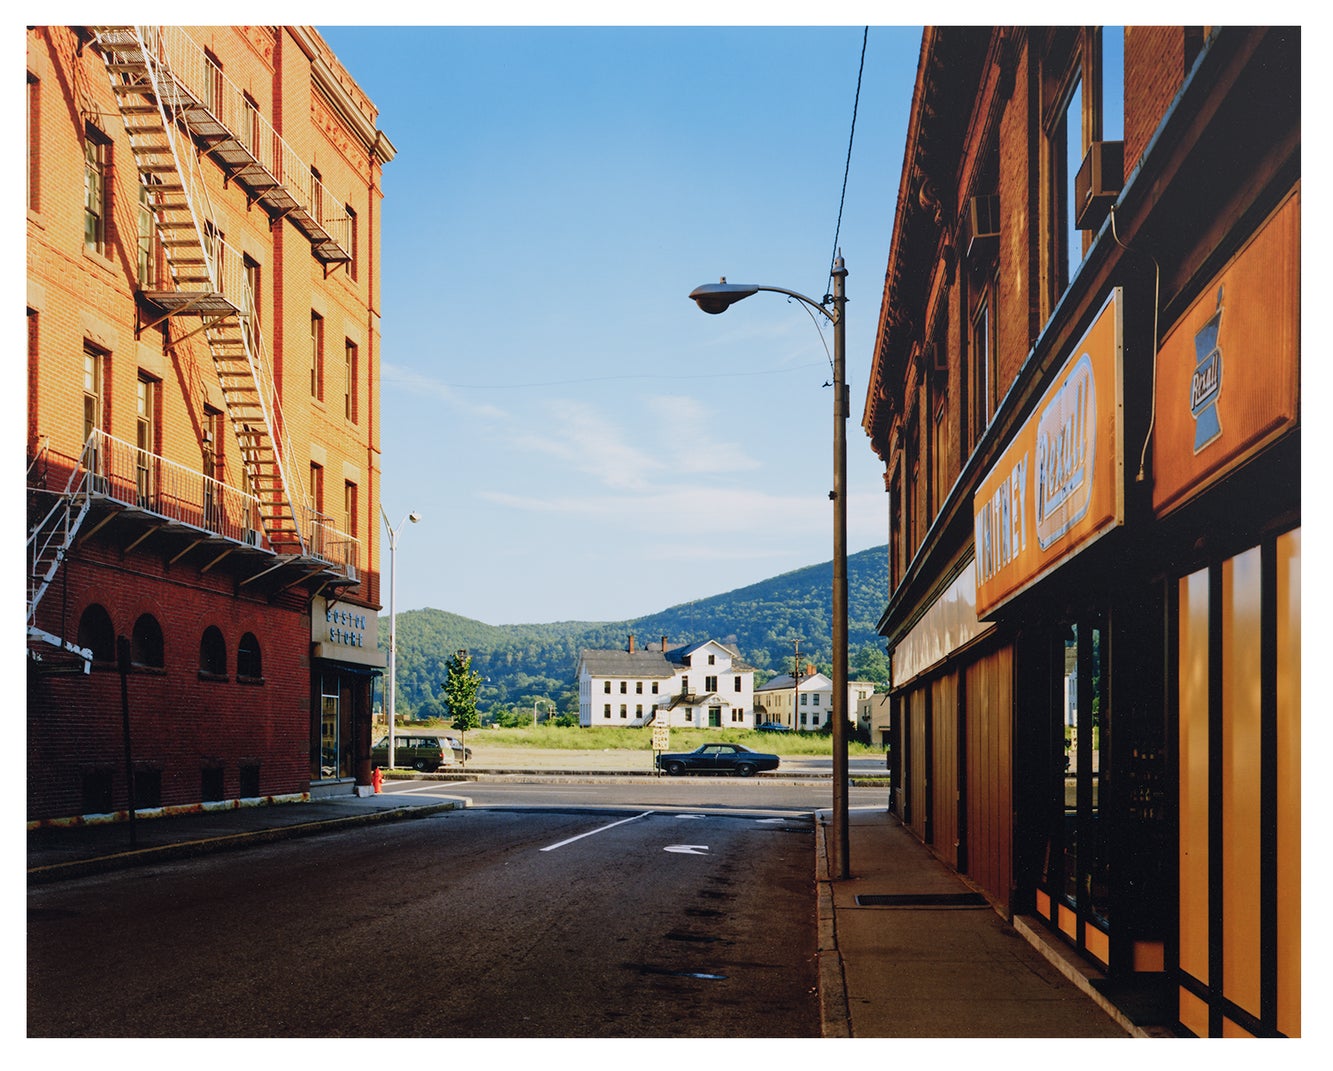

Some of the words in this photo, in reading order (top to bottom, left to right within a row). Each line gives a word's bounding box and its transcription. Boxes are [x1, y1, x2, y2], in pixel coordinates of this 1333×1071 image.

[1192, 354, 1219, 412] Rexall
[1039, 374, 1091, 528] Rexall
[975, 451, 1030, 590] WHITNEY
[326, 609, 366, 630] BOSTON
[330, 626, 363, 648] STORE
